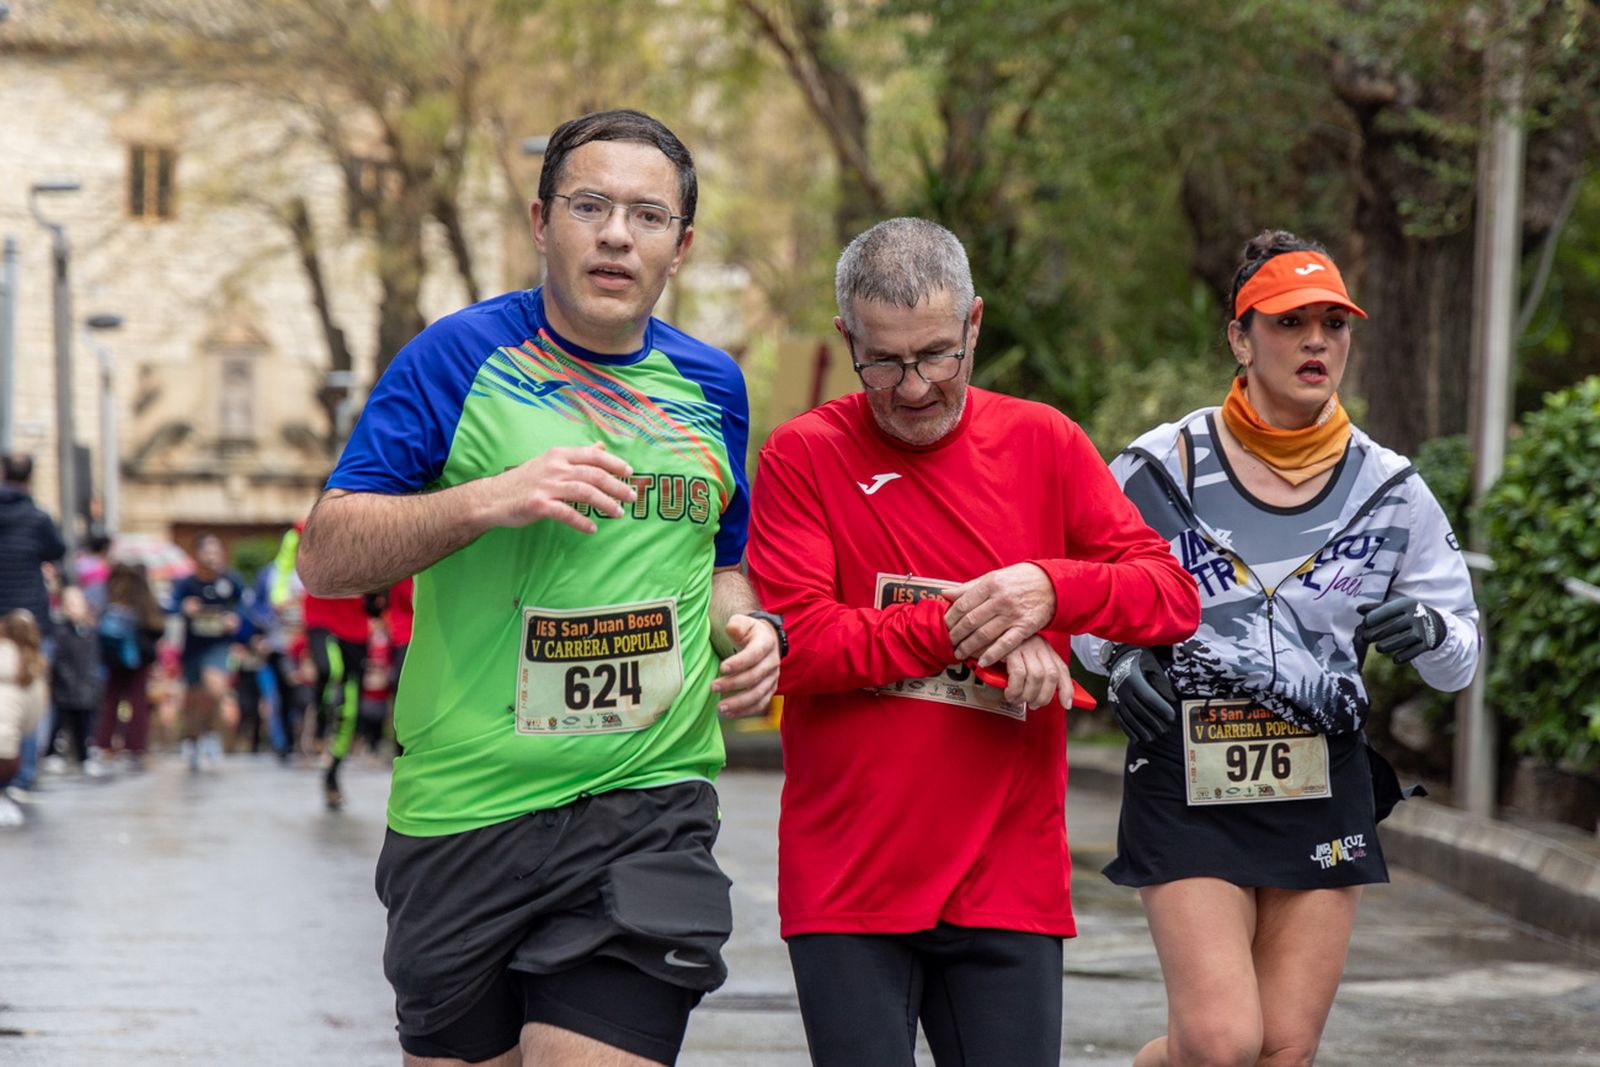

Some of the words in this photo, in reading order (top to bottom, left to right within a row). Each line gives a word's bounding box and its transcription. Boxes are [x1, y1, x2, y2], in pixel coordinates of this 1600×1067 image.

[893, 587, 914, 603] IES
[536, 620, 556, 637] IES
[561, 621, 588, 637] San
[592, 618, 624, 635] Juan
[628, 612, 663, 629] Bosco
[531, 640, 541, 657] V
[545, 638, 609, 659] CARRERA
[614, 630, 669, 653] POPULAR
[564, 660, 642, 711] 624
[1220, 708, 1243, 721] San
[1195, 725, 1204, 740] V
[1208, 722, 1262, 740] CARRERA
[1226, 742, 1291, 782] 976
